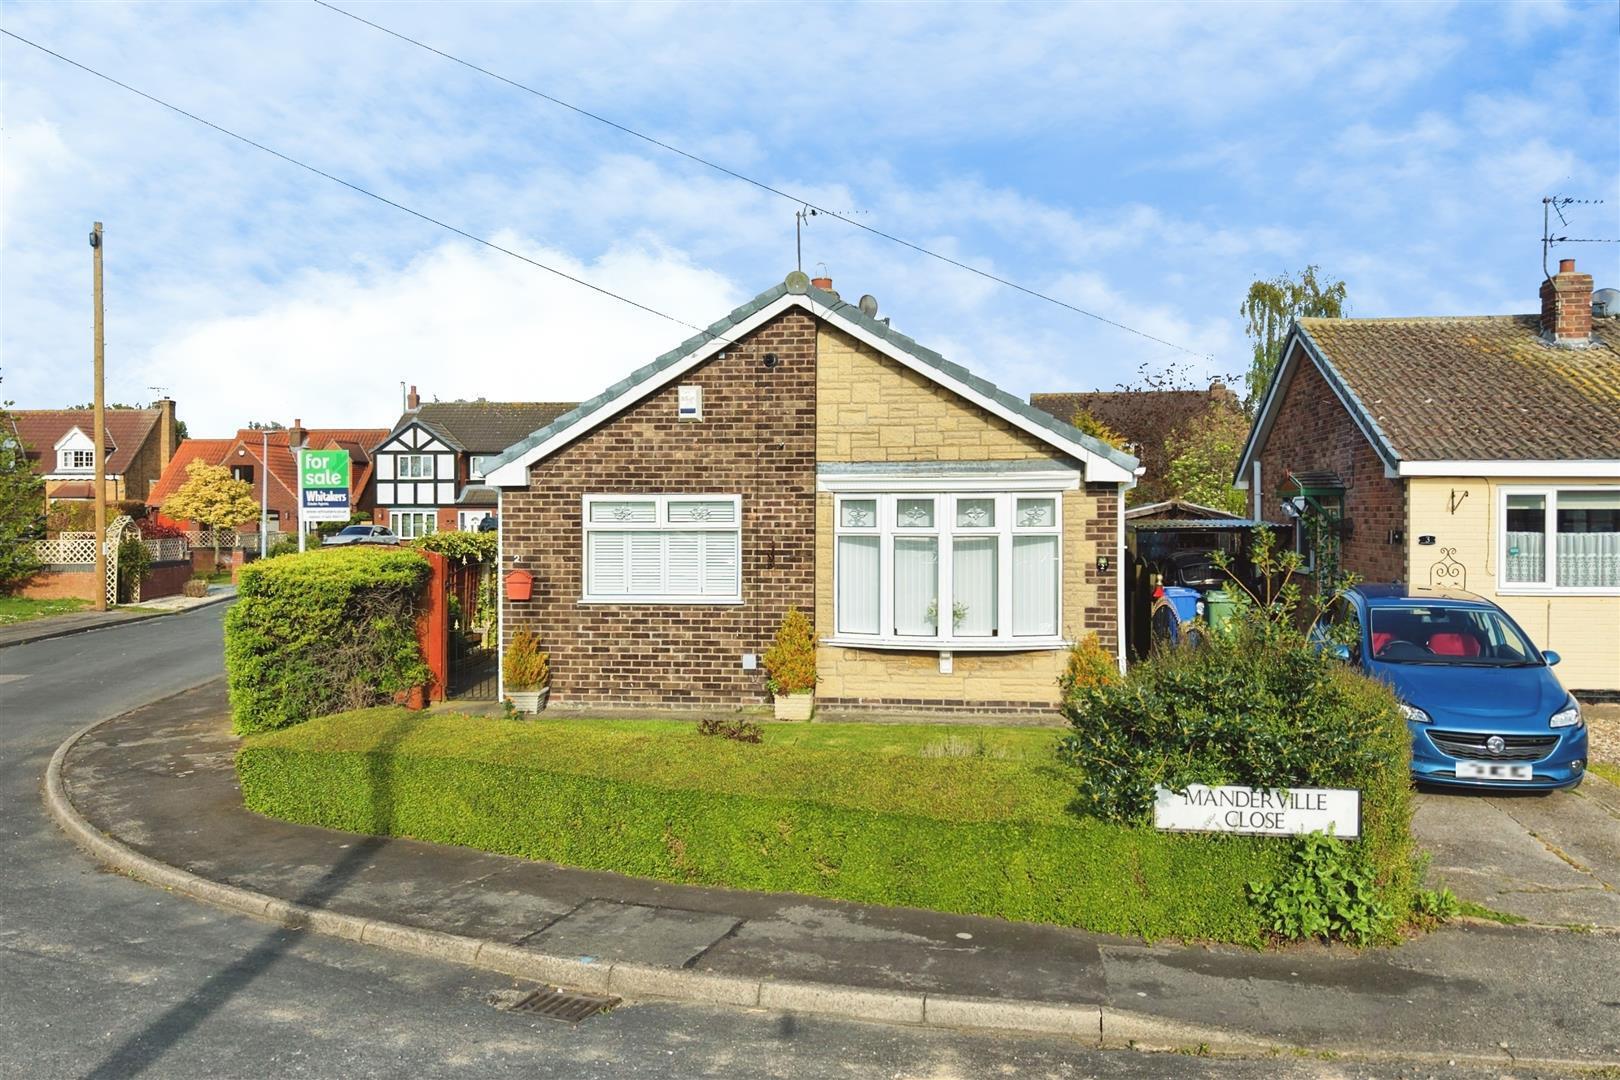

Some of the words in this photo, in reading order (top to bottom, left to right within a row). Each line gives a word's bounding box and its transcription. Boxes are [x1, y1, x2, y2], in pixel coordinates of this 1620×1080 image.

[305, 453, 330, 470] for
[305, 469, 342, 485] sale
[305, 490, 347, 502] Whitakers
[513, 555, 521, 563] 2
[1184, 788, 1327, 811] MANDERVILLE
[1224, 810, 1285, 829] CLOSE
